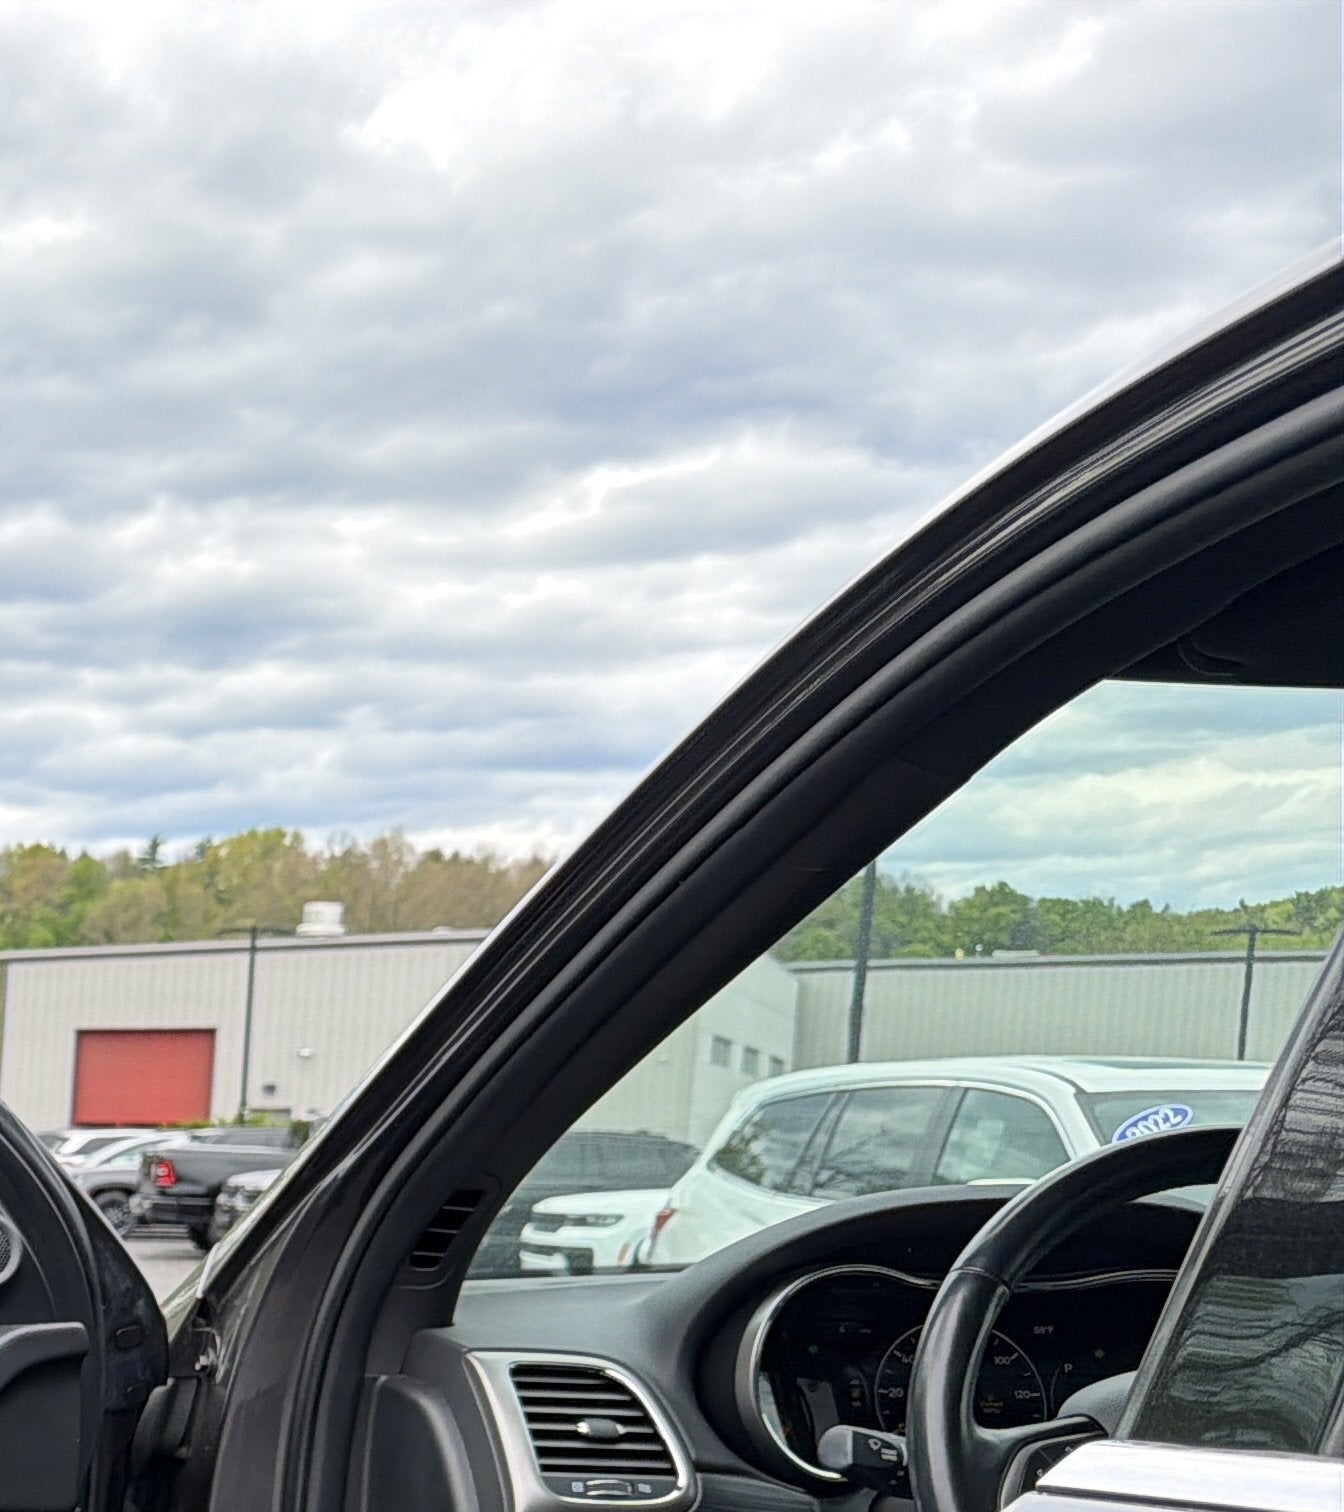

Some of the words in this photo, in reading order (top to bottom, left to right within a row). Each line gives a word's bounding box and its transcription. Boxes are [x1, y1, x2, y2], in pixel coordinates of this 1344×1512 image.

[994, 1356, 1011, 1365] 100
[1063, 1363, 1073, 1373] P
[888, 1387, 904, 1398] 20
[1014, 1390, 1031, 1399] 120
